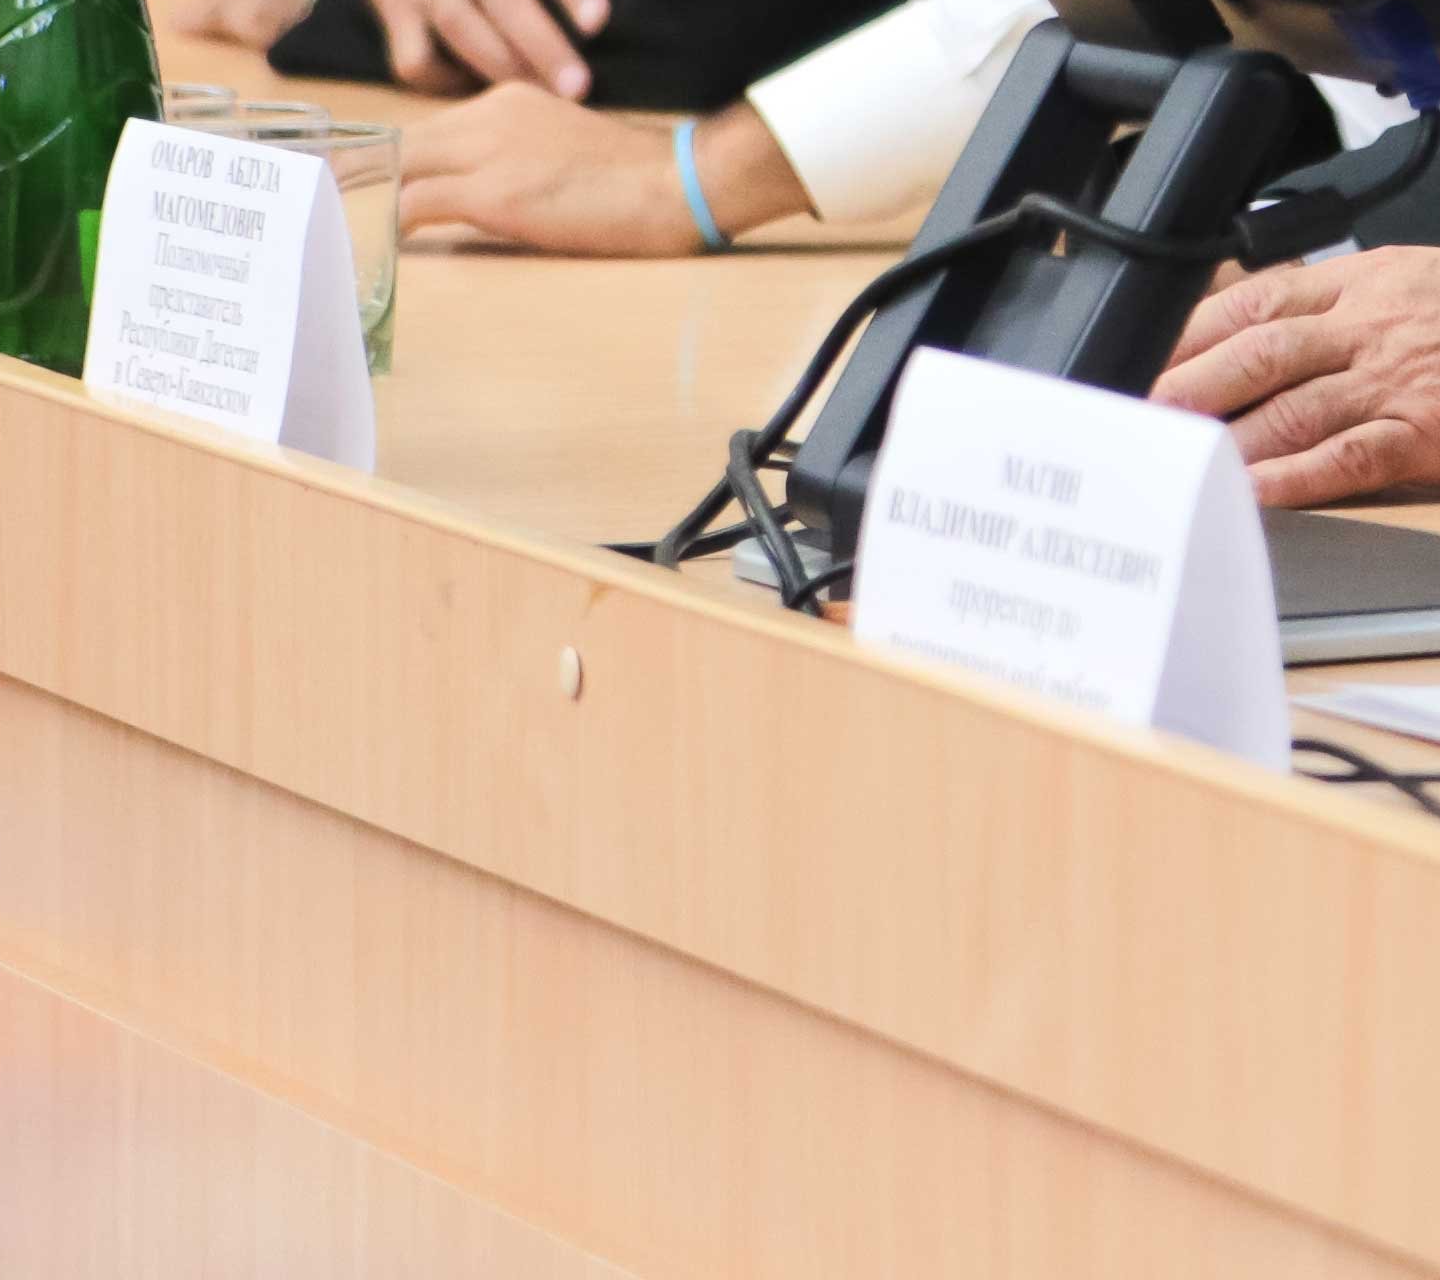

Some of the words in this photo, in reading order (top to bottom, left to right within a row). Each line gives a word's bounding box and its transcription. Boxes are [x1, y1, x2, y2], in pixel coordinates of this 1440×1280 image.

[151, 140, 214, 178] ОМАРОВ
[152, 191, 266, 242] МАГОМЕДОВИЧ
[888, 488, 1019, 552] ВЛАДИМИР
